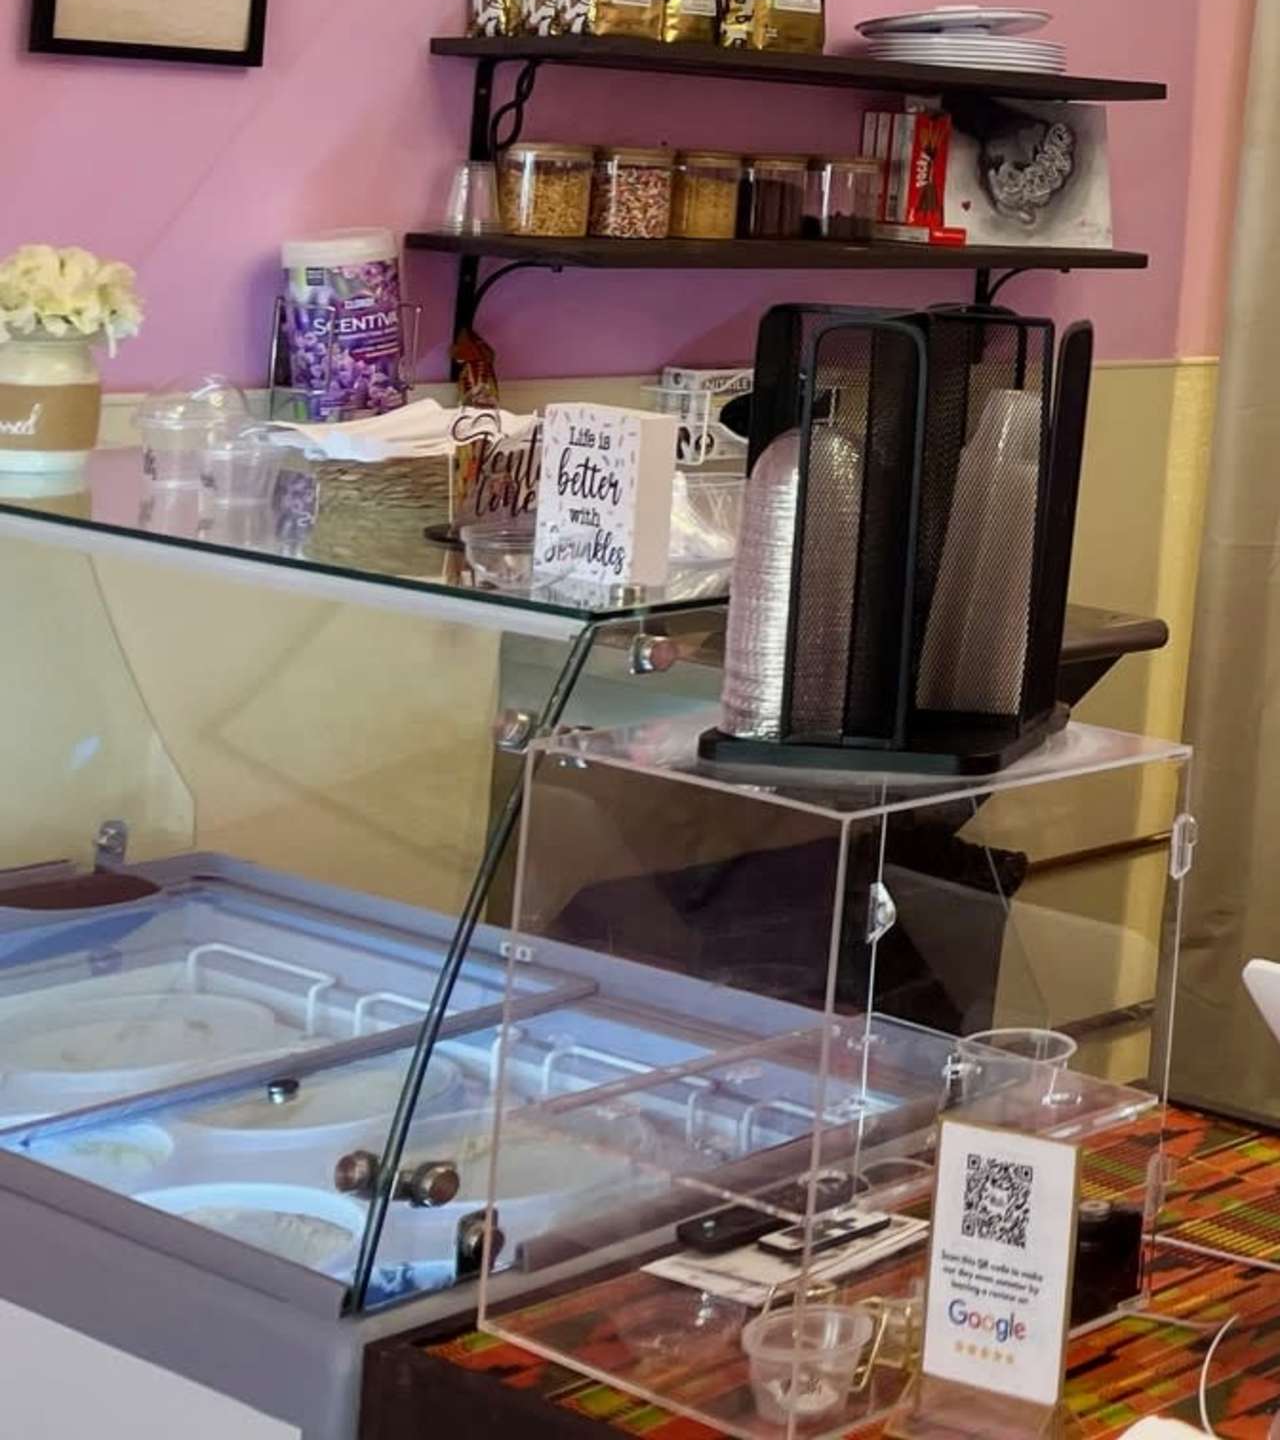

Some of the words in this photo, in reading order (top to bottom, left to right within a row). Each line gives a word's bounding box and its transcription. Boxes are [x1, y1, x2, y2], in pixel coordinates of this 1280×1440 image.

[569, 426, 595, 447] Life
[598, 431, 610, 450] is
[558, 447, 622, 506] better
[570, 509, 600, 528] with
[948, 1298, 1027, 1343] Google
